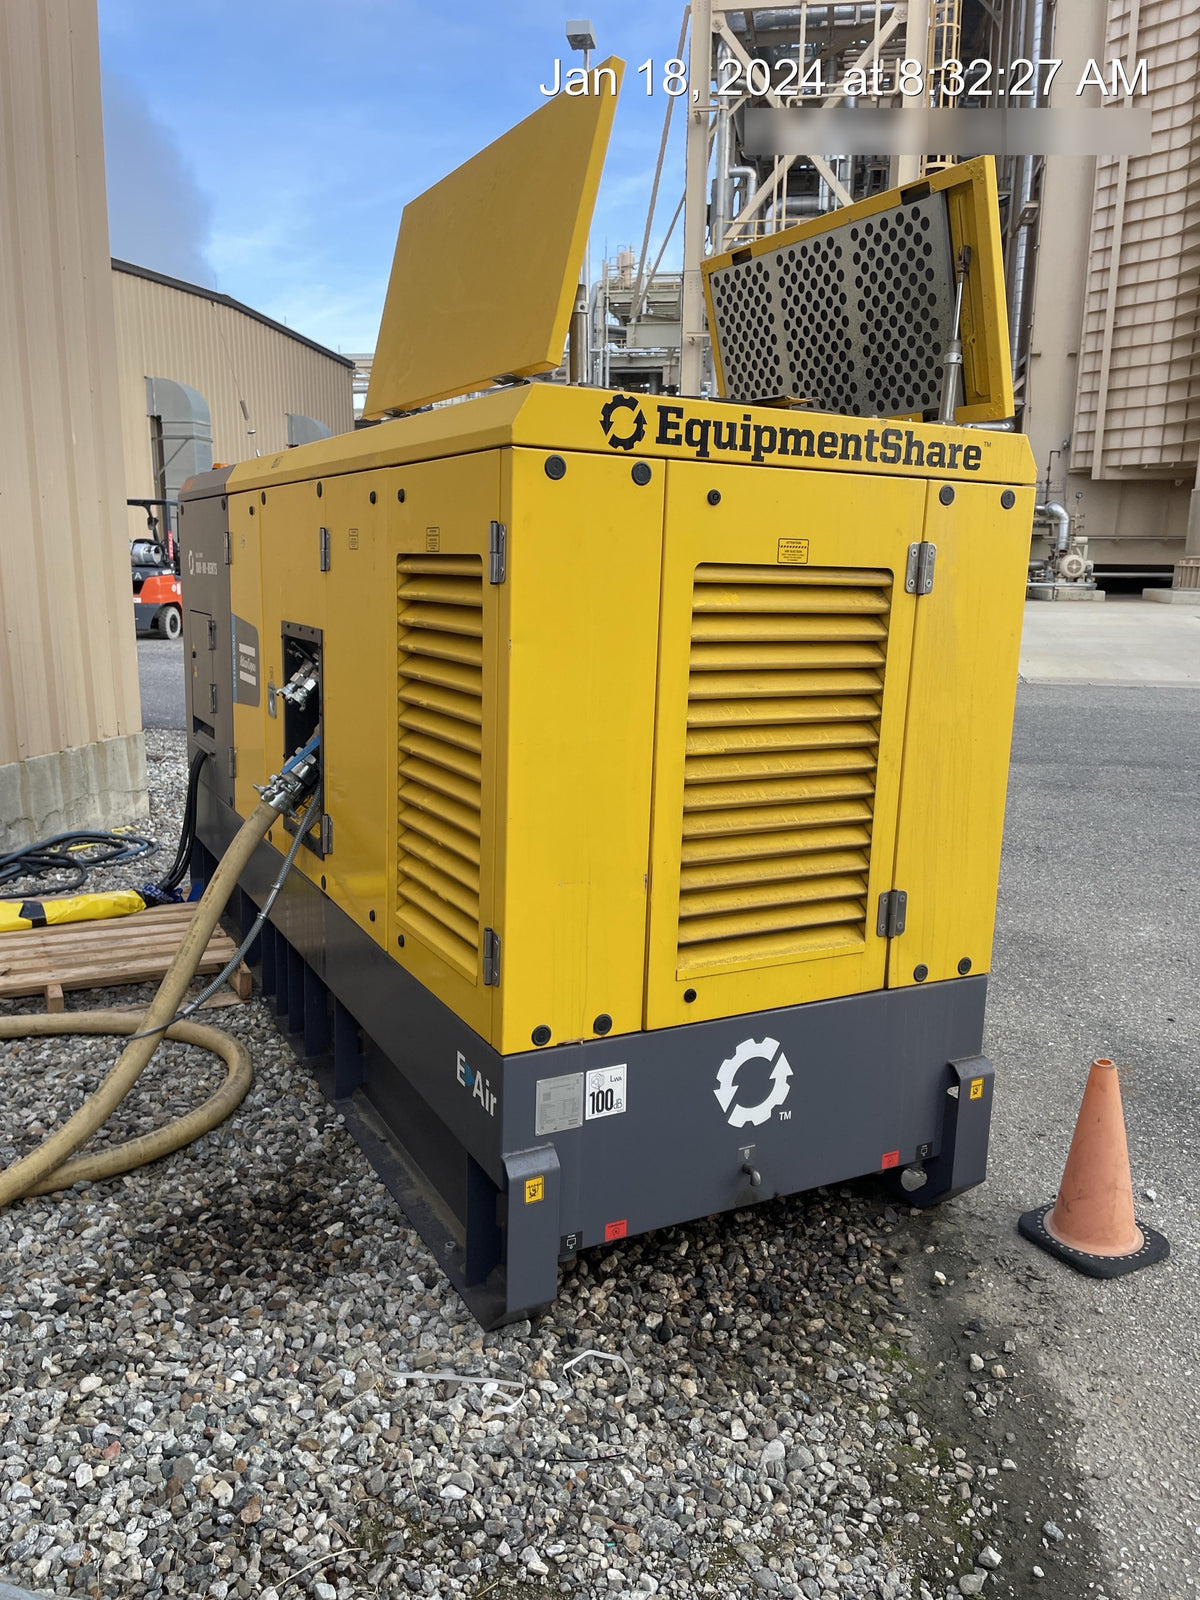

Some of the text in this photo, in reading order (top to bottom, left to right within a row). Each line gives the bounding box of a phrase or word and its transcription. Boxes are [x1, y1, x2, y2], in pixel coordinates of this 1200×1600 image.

[655, 405, 982, 471] EquipmentShare
[589, 1088, 623, 1115] 100 dB
